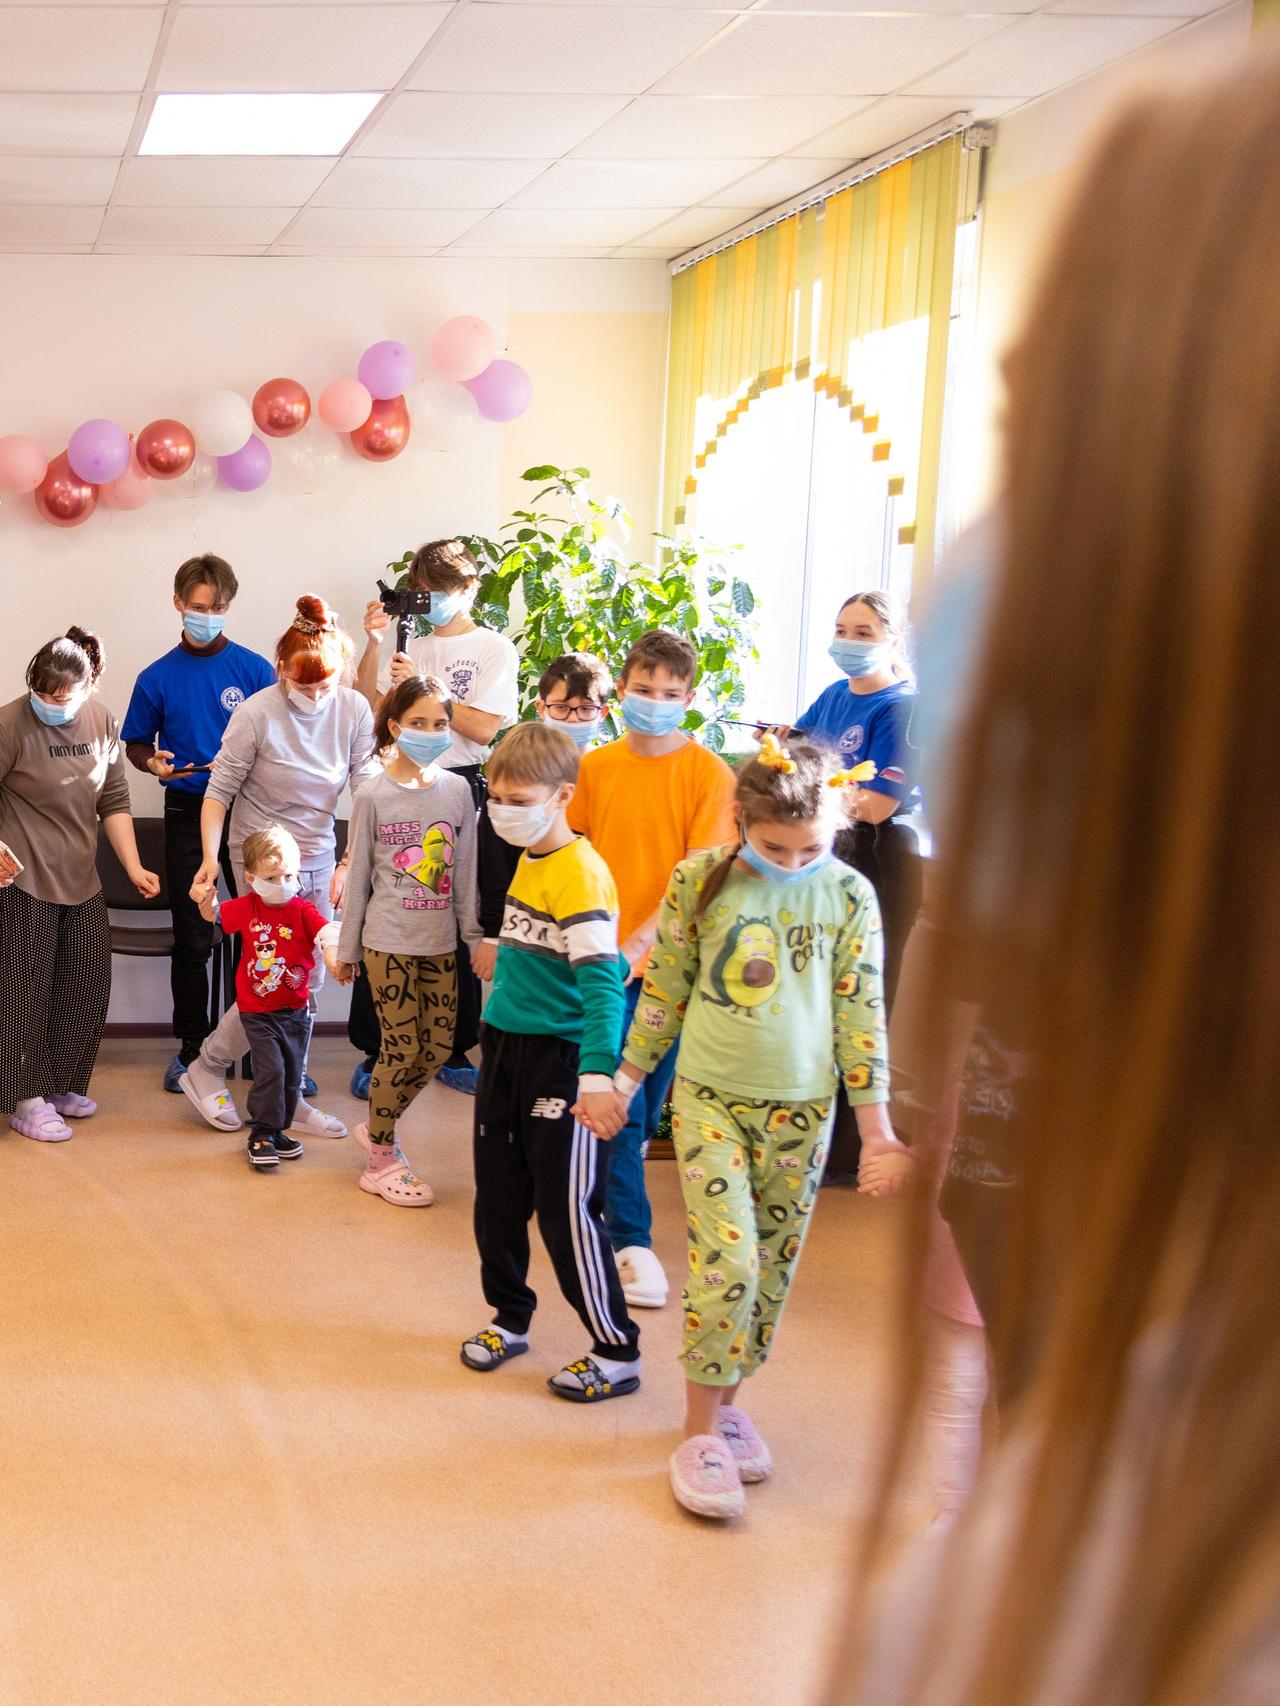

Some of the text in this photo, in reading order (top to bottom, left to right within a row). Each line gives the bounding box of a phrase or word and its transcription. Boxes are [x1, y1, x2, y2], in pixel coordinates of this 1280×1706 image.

[380, 821, 420, 836] MISS
[381, 832, 421, 845] PIGGY
[412, 885, 425, 899] 4
[403, 896, 452, 911] KERM
